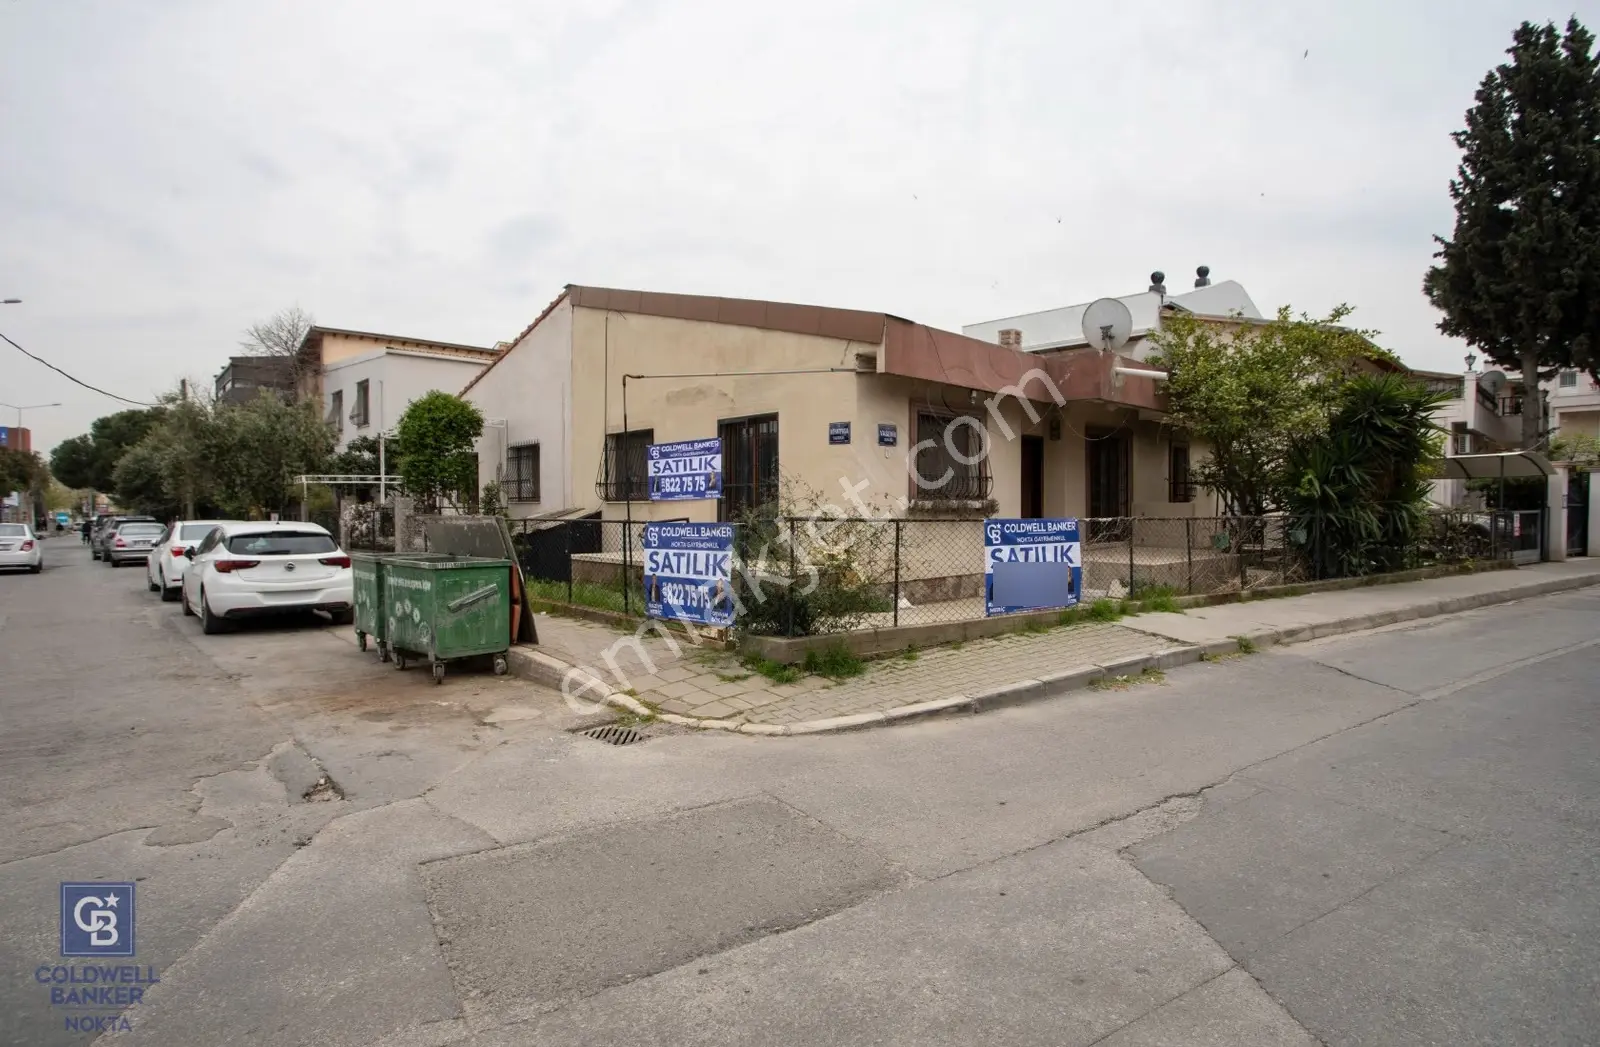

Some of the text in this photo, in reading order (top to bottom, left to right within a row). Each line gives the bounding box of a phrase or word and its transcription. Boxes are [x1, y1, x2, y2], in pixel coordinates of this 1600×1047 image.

[661, 440, 719, 452] COLDWELL BANKER
[653, 456, 717, 474] SATILIK
[665, 476, 681, 493] 822
[682, 476, 693, 492] 75
[694, 475, 706, 491] 75
[661, 526, 732, 537] COLDWELL BANKER
[1004, 521, 1076, 533] COLDWELL BANKER
[648, 550, 728, 577] SATILIK
[667, 582, 685, 605] 822
[687, 584, 697, 608] 75
[699, 585, 710, 609] 75
